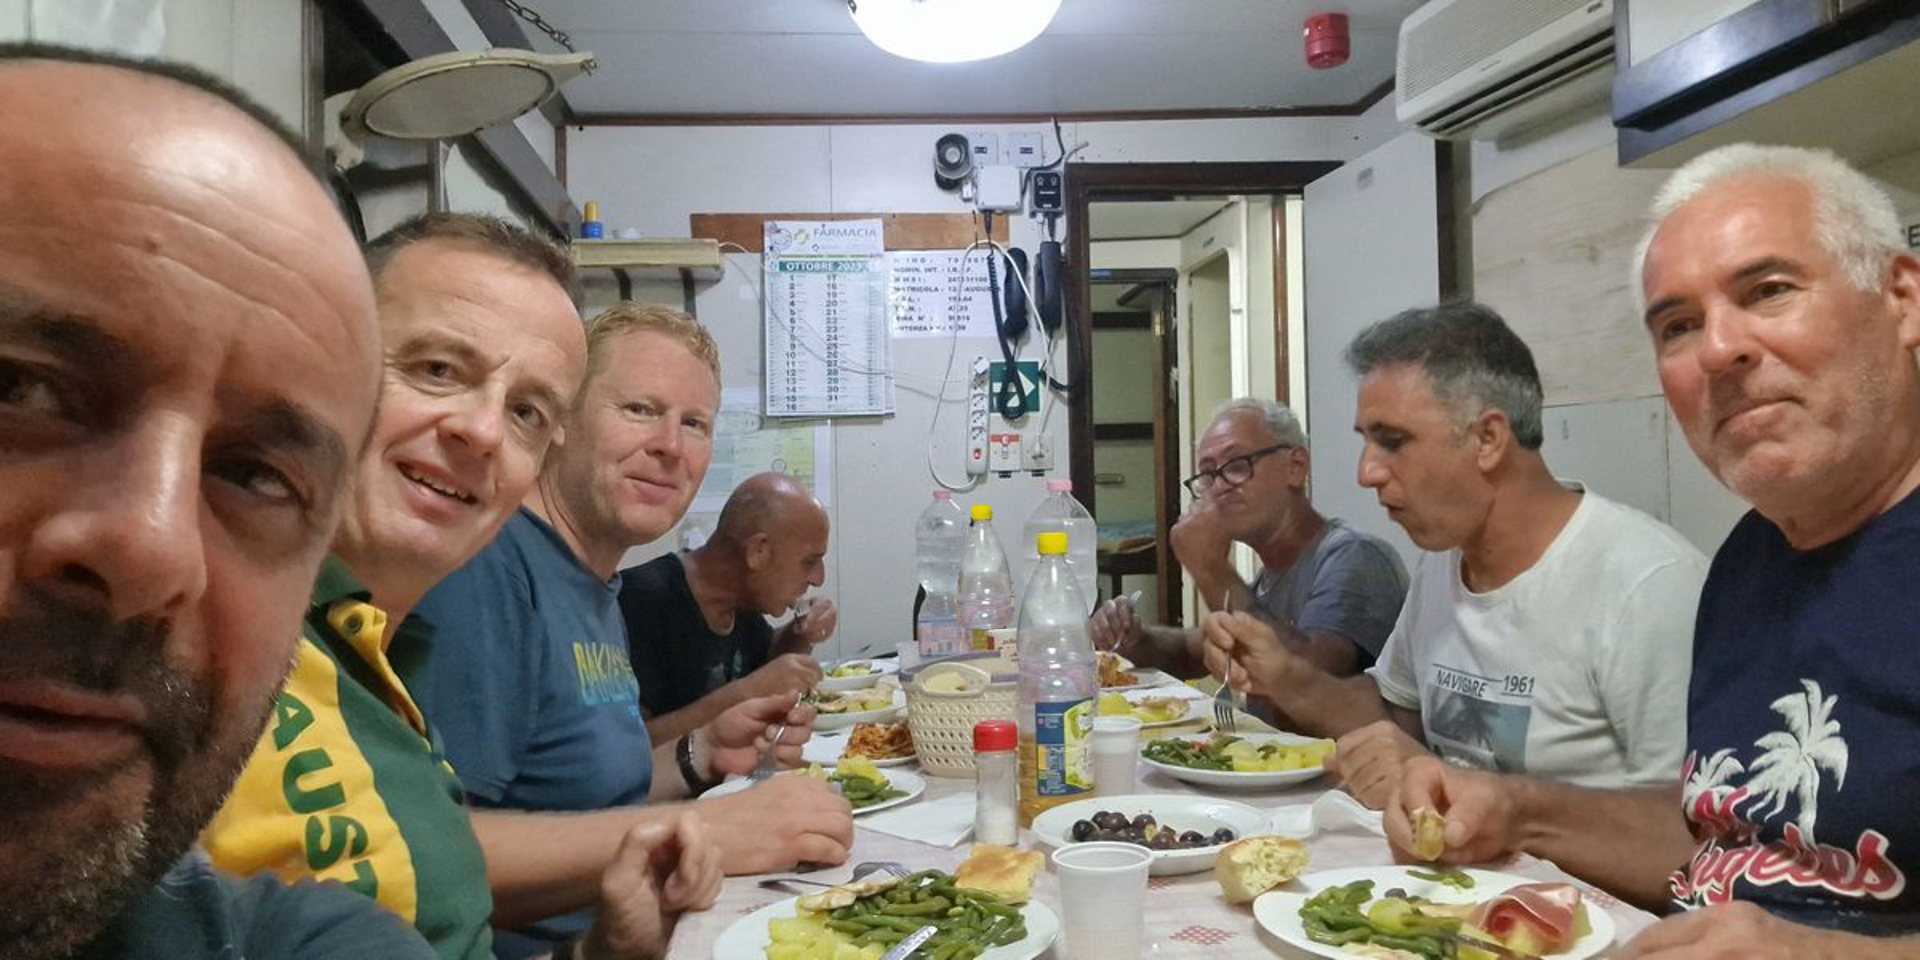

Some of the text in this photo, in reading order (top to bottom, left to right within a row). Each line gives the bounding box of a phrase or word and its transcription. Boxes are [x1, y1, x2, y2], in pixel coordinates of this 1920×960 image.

[813, 228, 877, 238] FARMACIA
[786, 261, 834, 271] OTTOBRE
[1436, 669, 1488, 698] NAVIGARE
[1503, 675, 1536, 693] 1961
